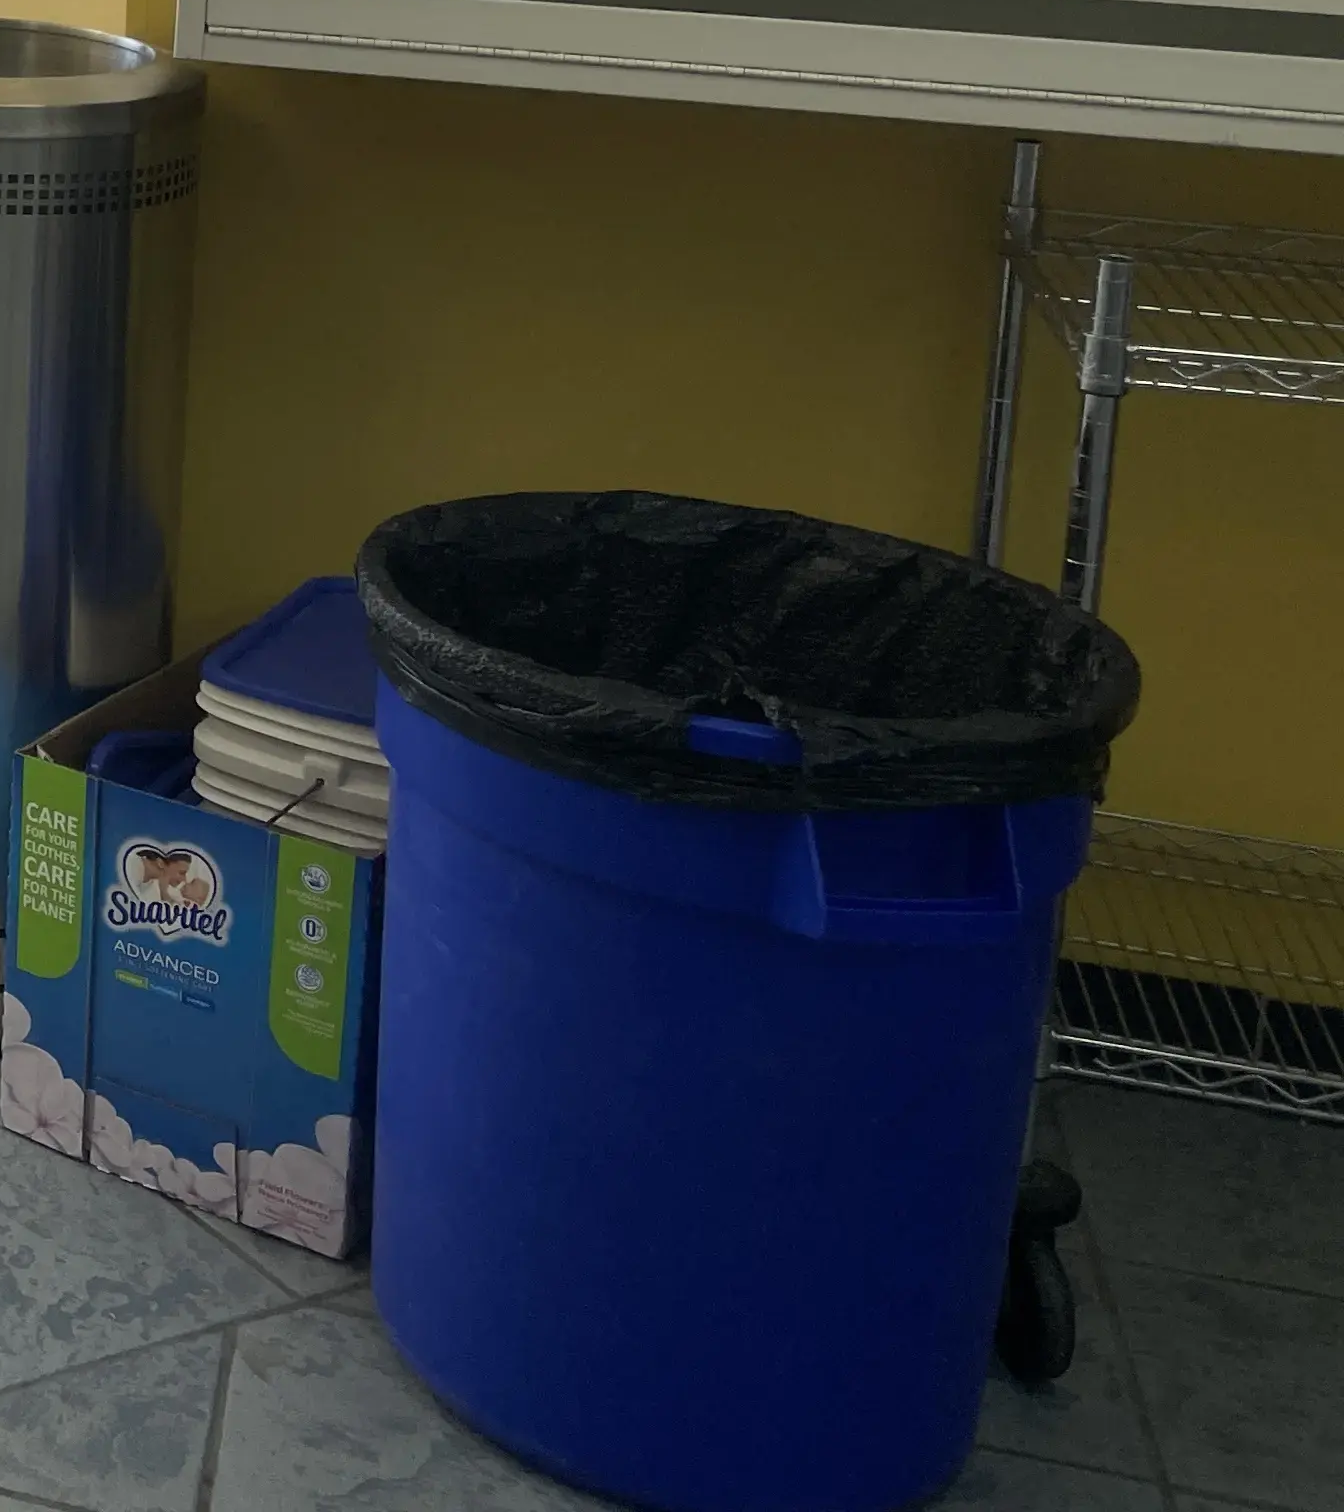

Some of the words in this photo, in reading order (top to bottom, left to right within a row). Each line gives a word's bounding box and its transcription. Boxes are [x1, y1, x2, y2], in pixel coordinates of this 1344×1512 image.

[26, 802, 79, 837] CARE
[26, 824, 45, 841] FOR
[49, 831, 77, 852] YOUR
[24, 839, 80, 871] CLOTHES,
[24, 855, 76, 891] CARE
[23, 878, 48, 898] FOR
[51, 888, 76, 908] THE
[23, 894, 76, 925] PLANET
[108, 890, 227, 941] Suavitel
[114, 939, 220, 985] ADVANCED
